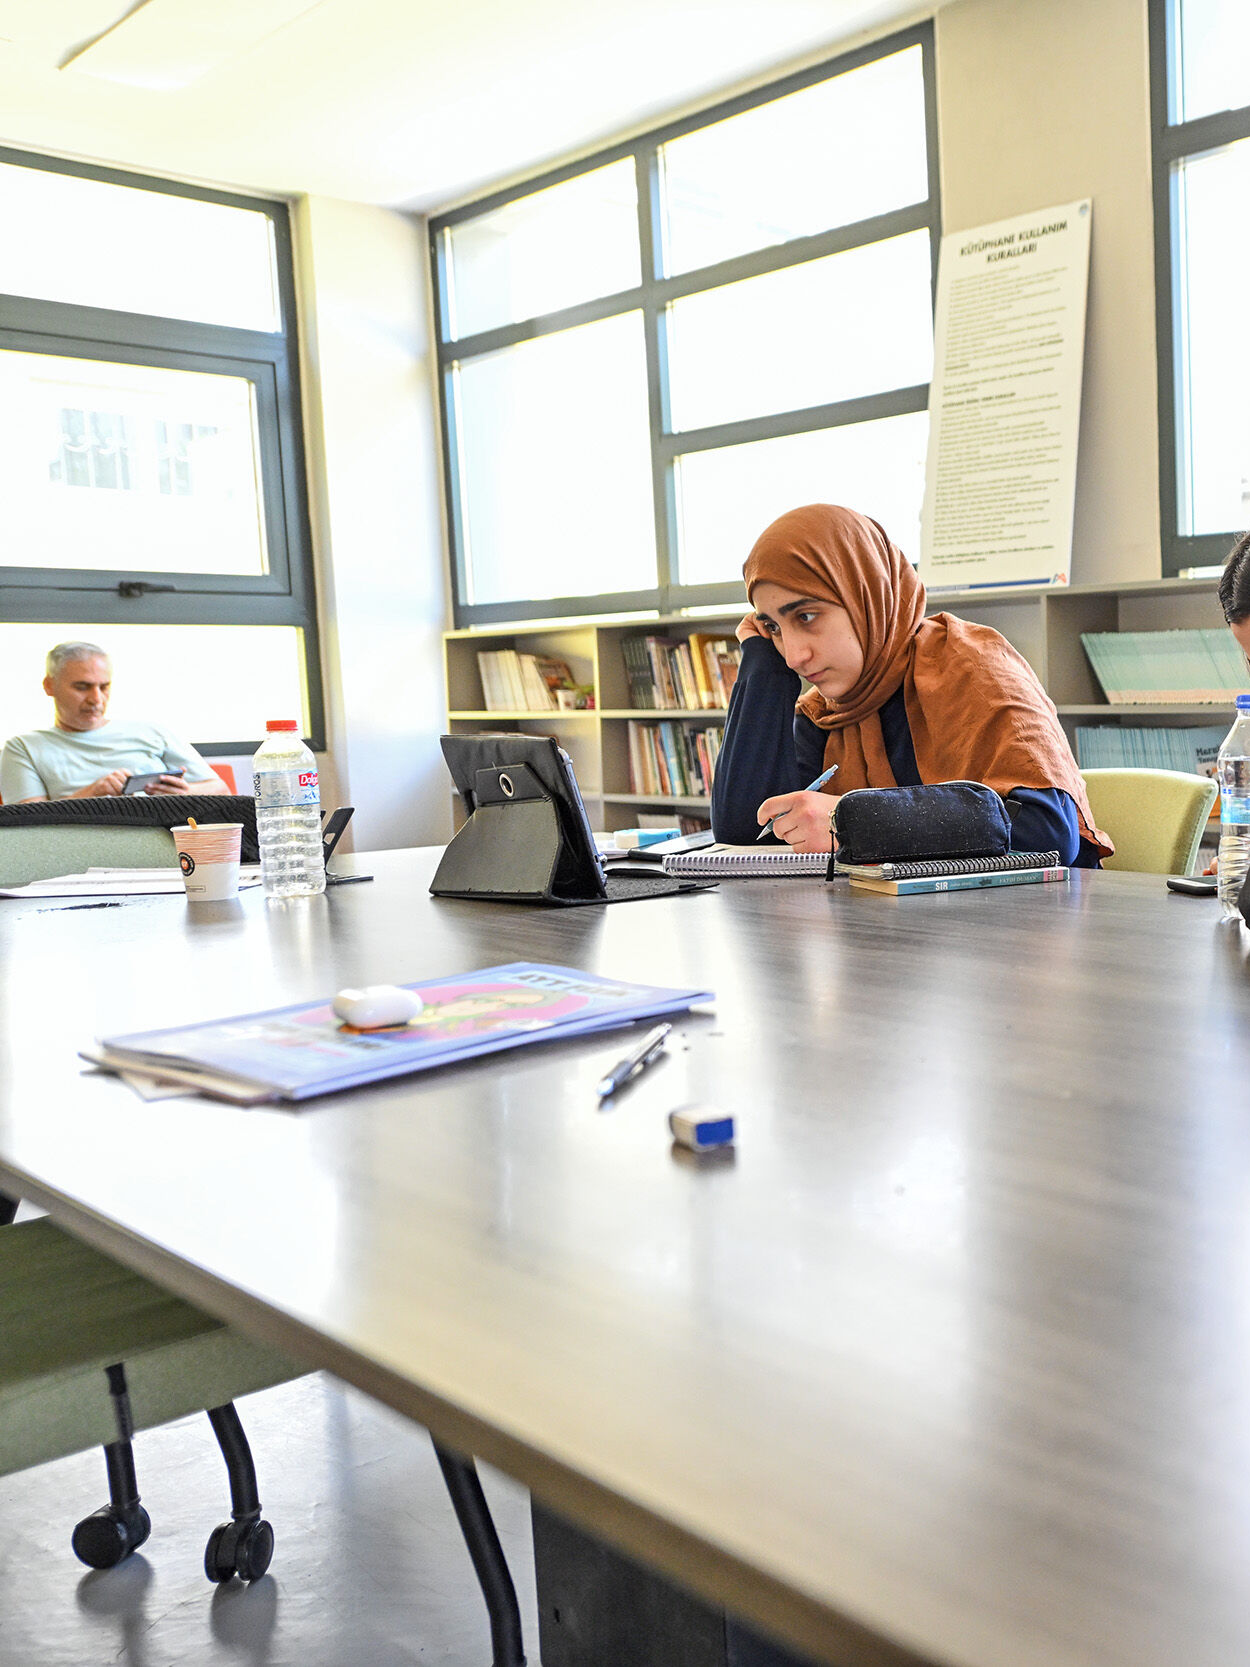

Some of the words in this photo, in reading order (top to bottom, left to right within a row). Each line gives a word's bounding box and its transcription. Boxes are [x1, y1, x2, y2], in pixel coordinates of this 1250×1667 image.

[960, 233, 1016, 256] KÜTÜPHANE
[1018, 220, 1068, 241] KULLANIM
[987, 242, 1038, 263] KURALLARI
[253, 774, 262, 801] TOROS
[935, 881, 948, 891] SIR
